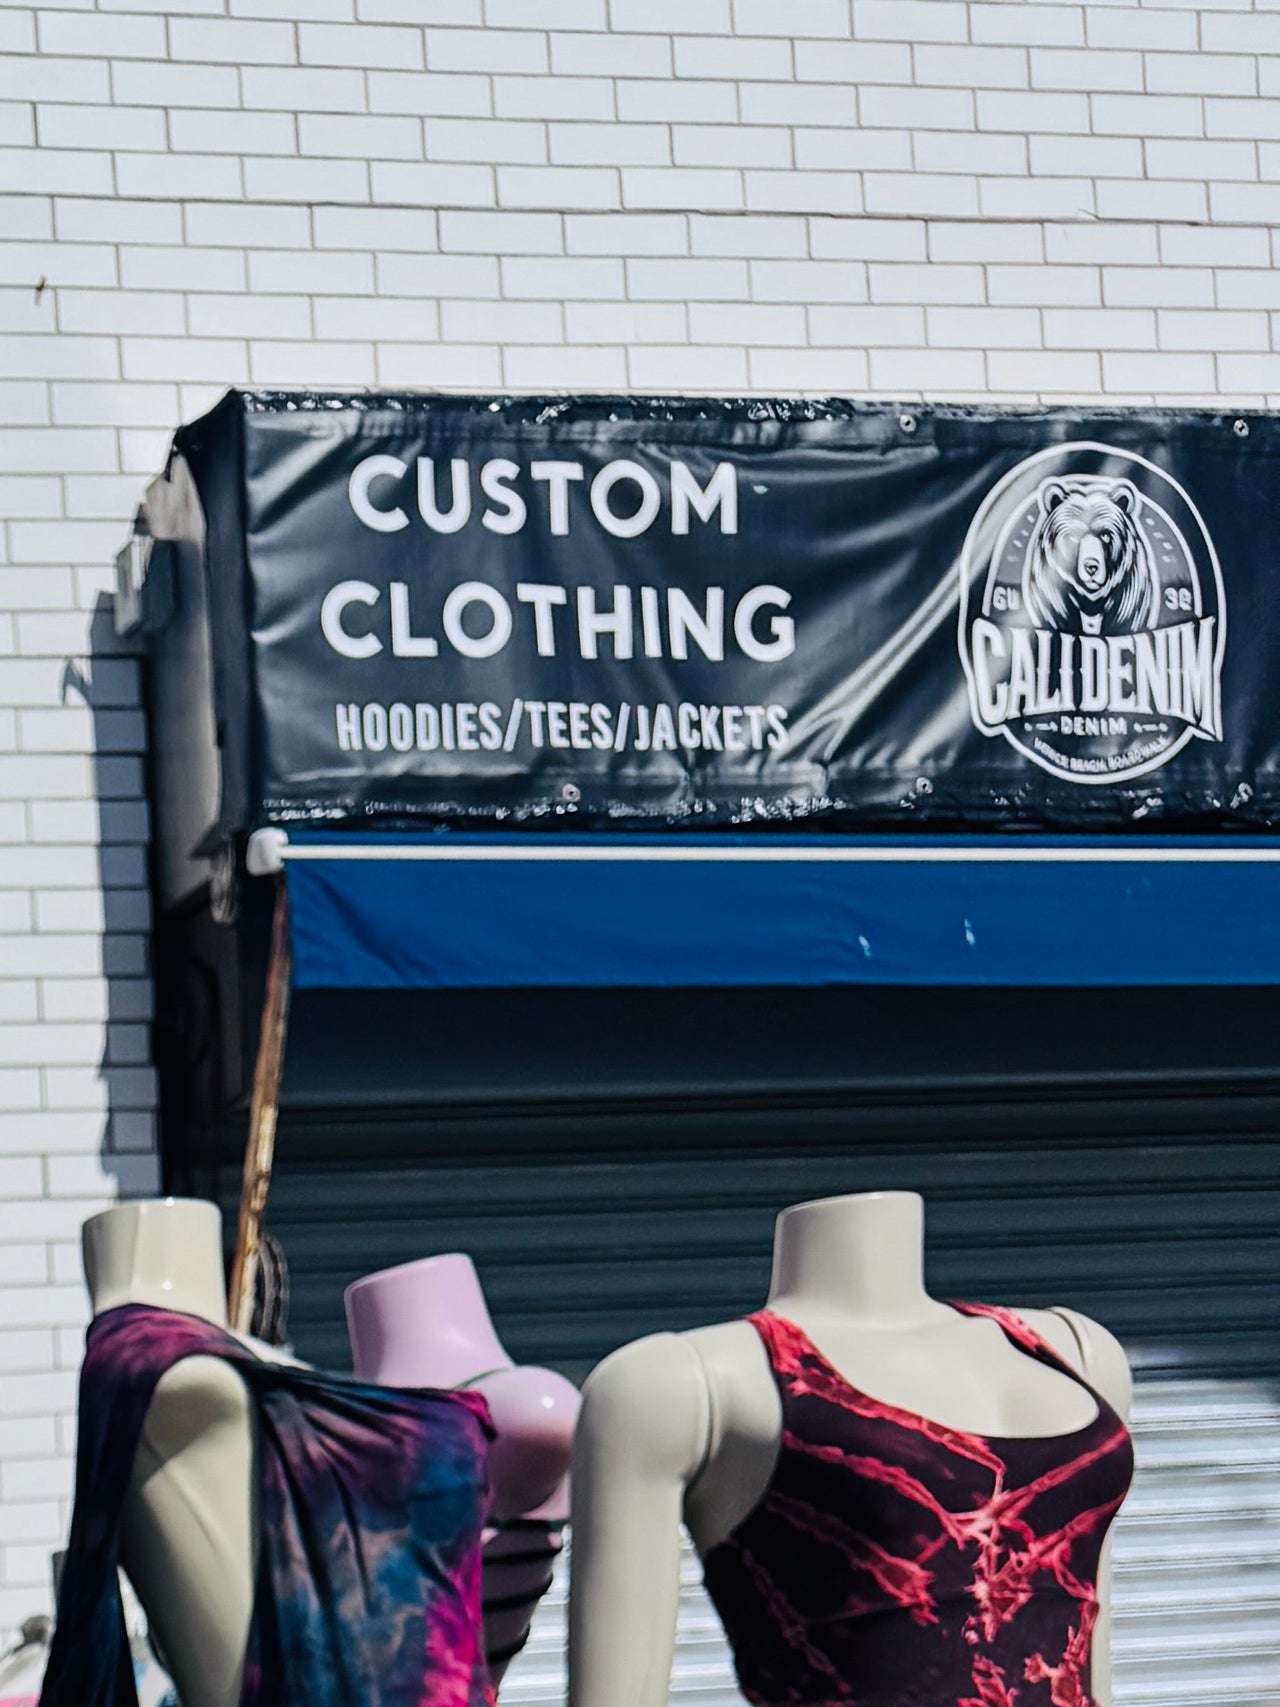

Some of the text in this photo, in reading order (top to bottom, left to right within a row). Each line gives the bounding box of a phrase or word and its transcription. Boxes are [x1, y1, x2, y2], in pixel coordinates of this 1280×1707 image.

[347, 453, 739, 538] CUSTOM
[319, 580, 797, 664] CLOTHING
[1060, 715, 1128, 736] DENIM
